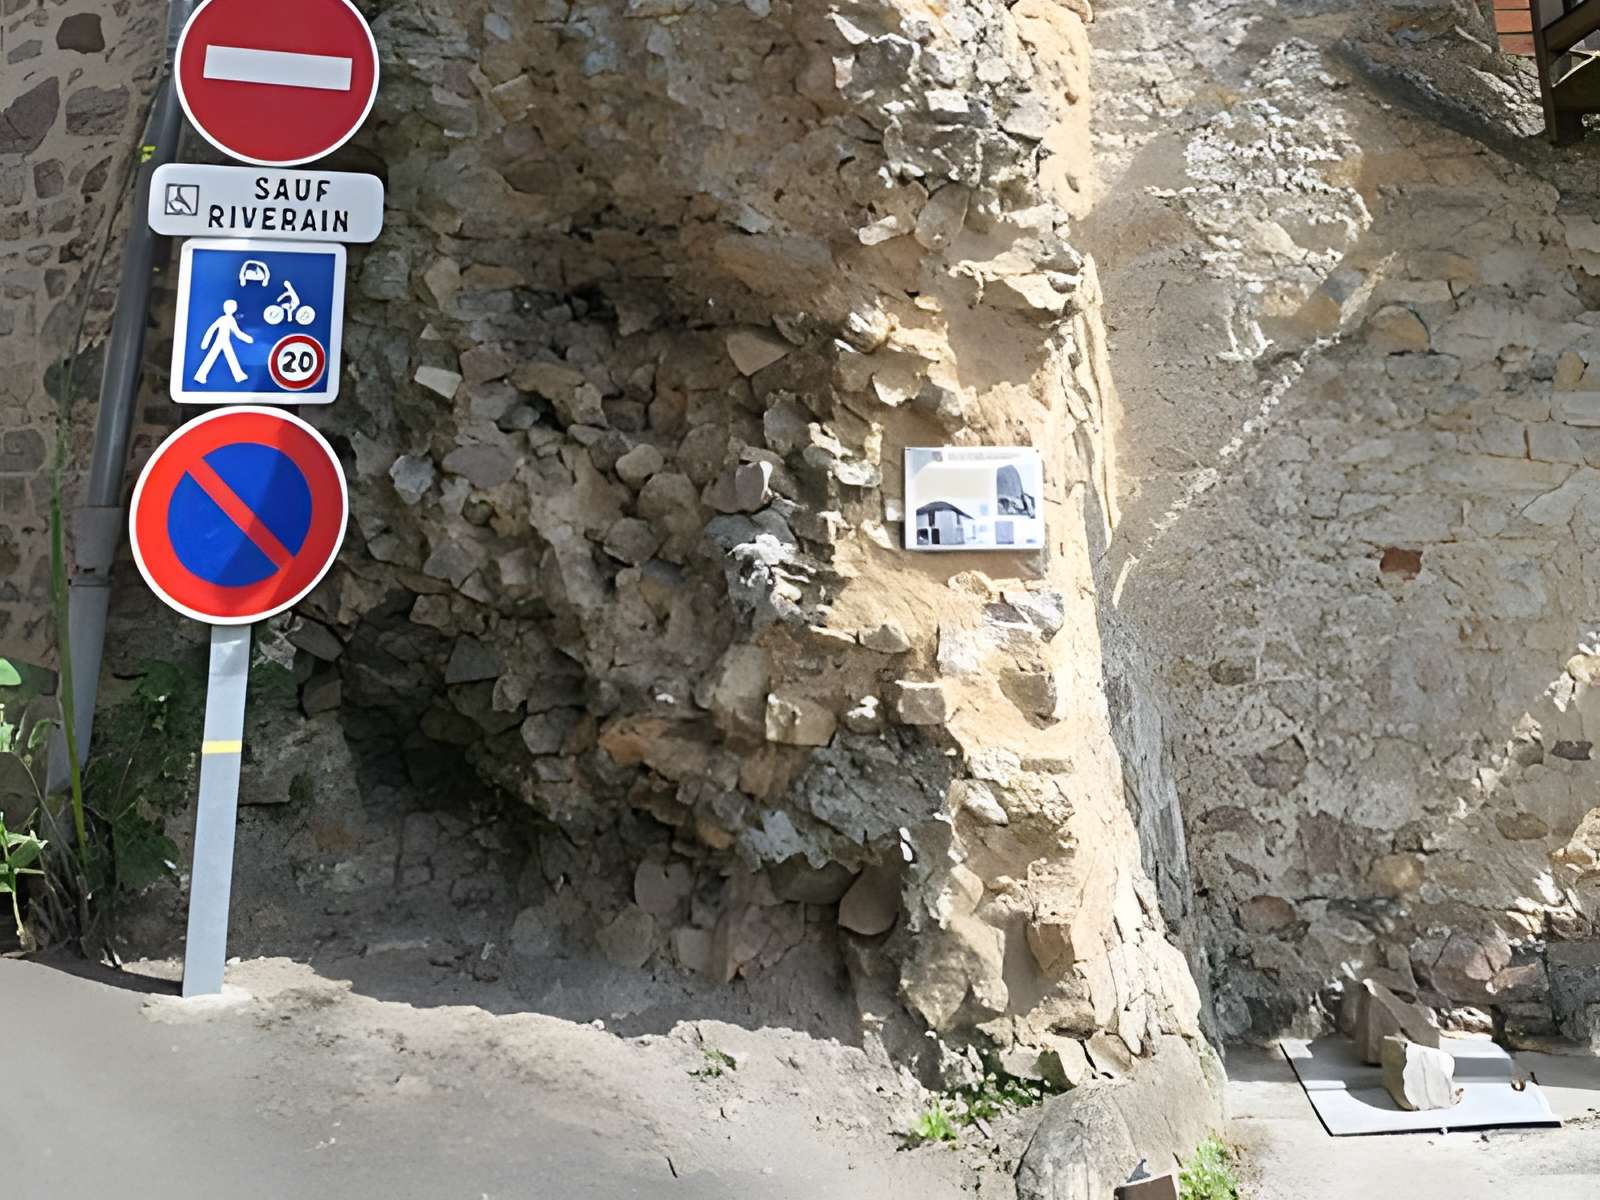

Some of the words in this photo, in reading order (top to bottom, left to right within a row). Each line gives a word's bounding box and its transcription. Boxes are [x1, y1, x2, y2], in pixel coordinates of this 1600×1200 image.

[254, 176, 331, 202] SAUF
[207, 203, 349, 232] RIVERAIN
[281, 350, 314, 373] 20
